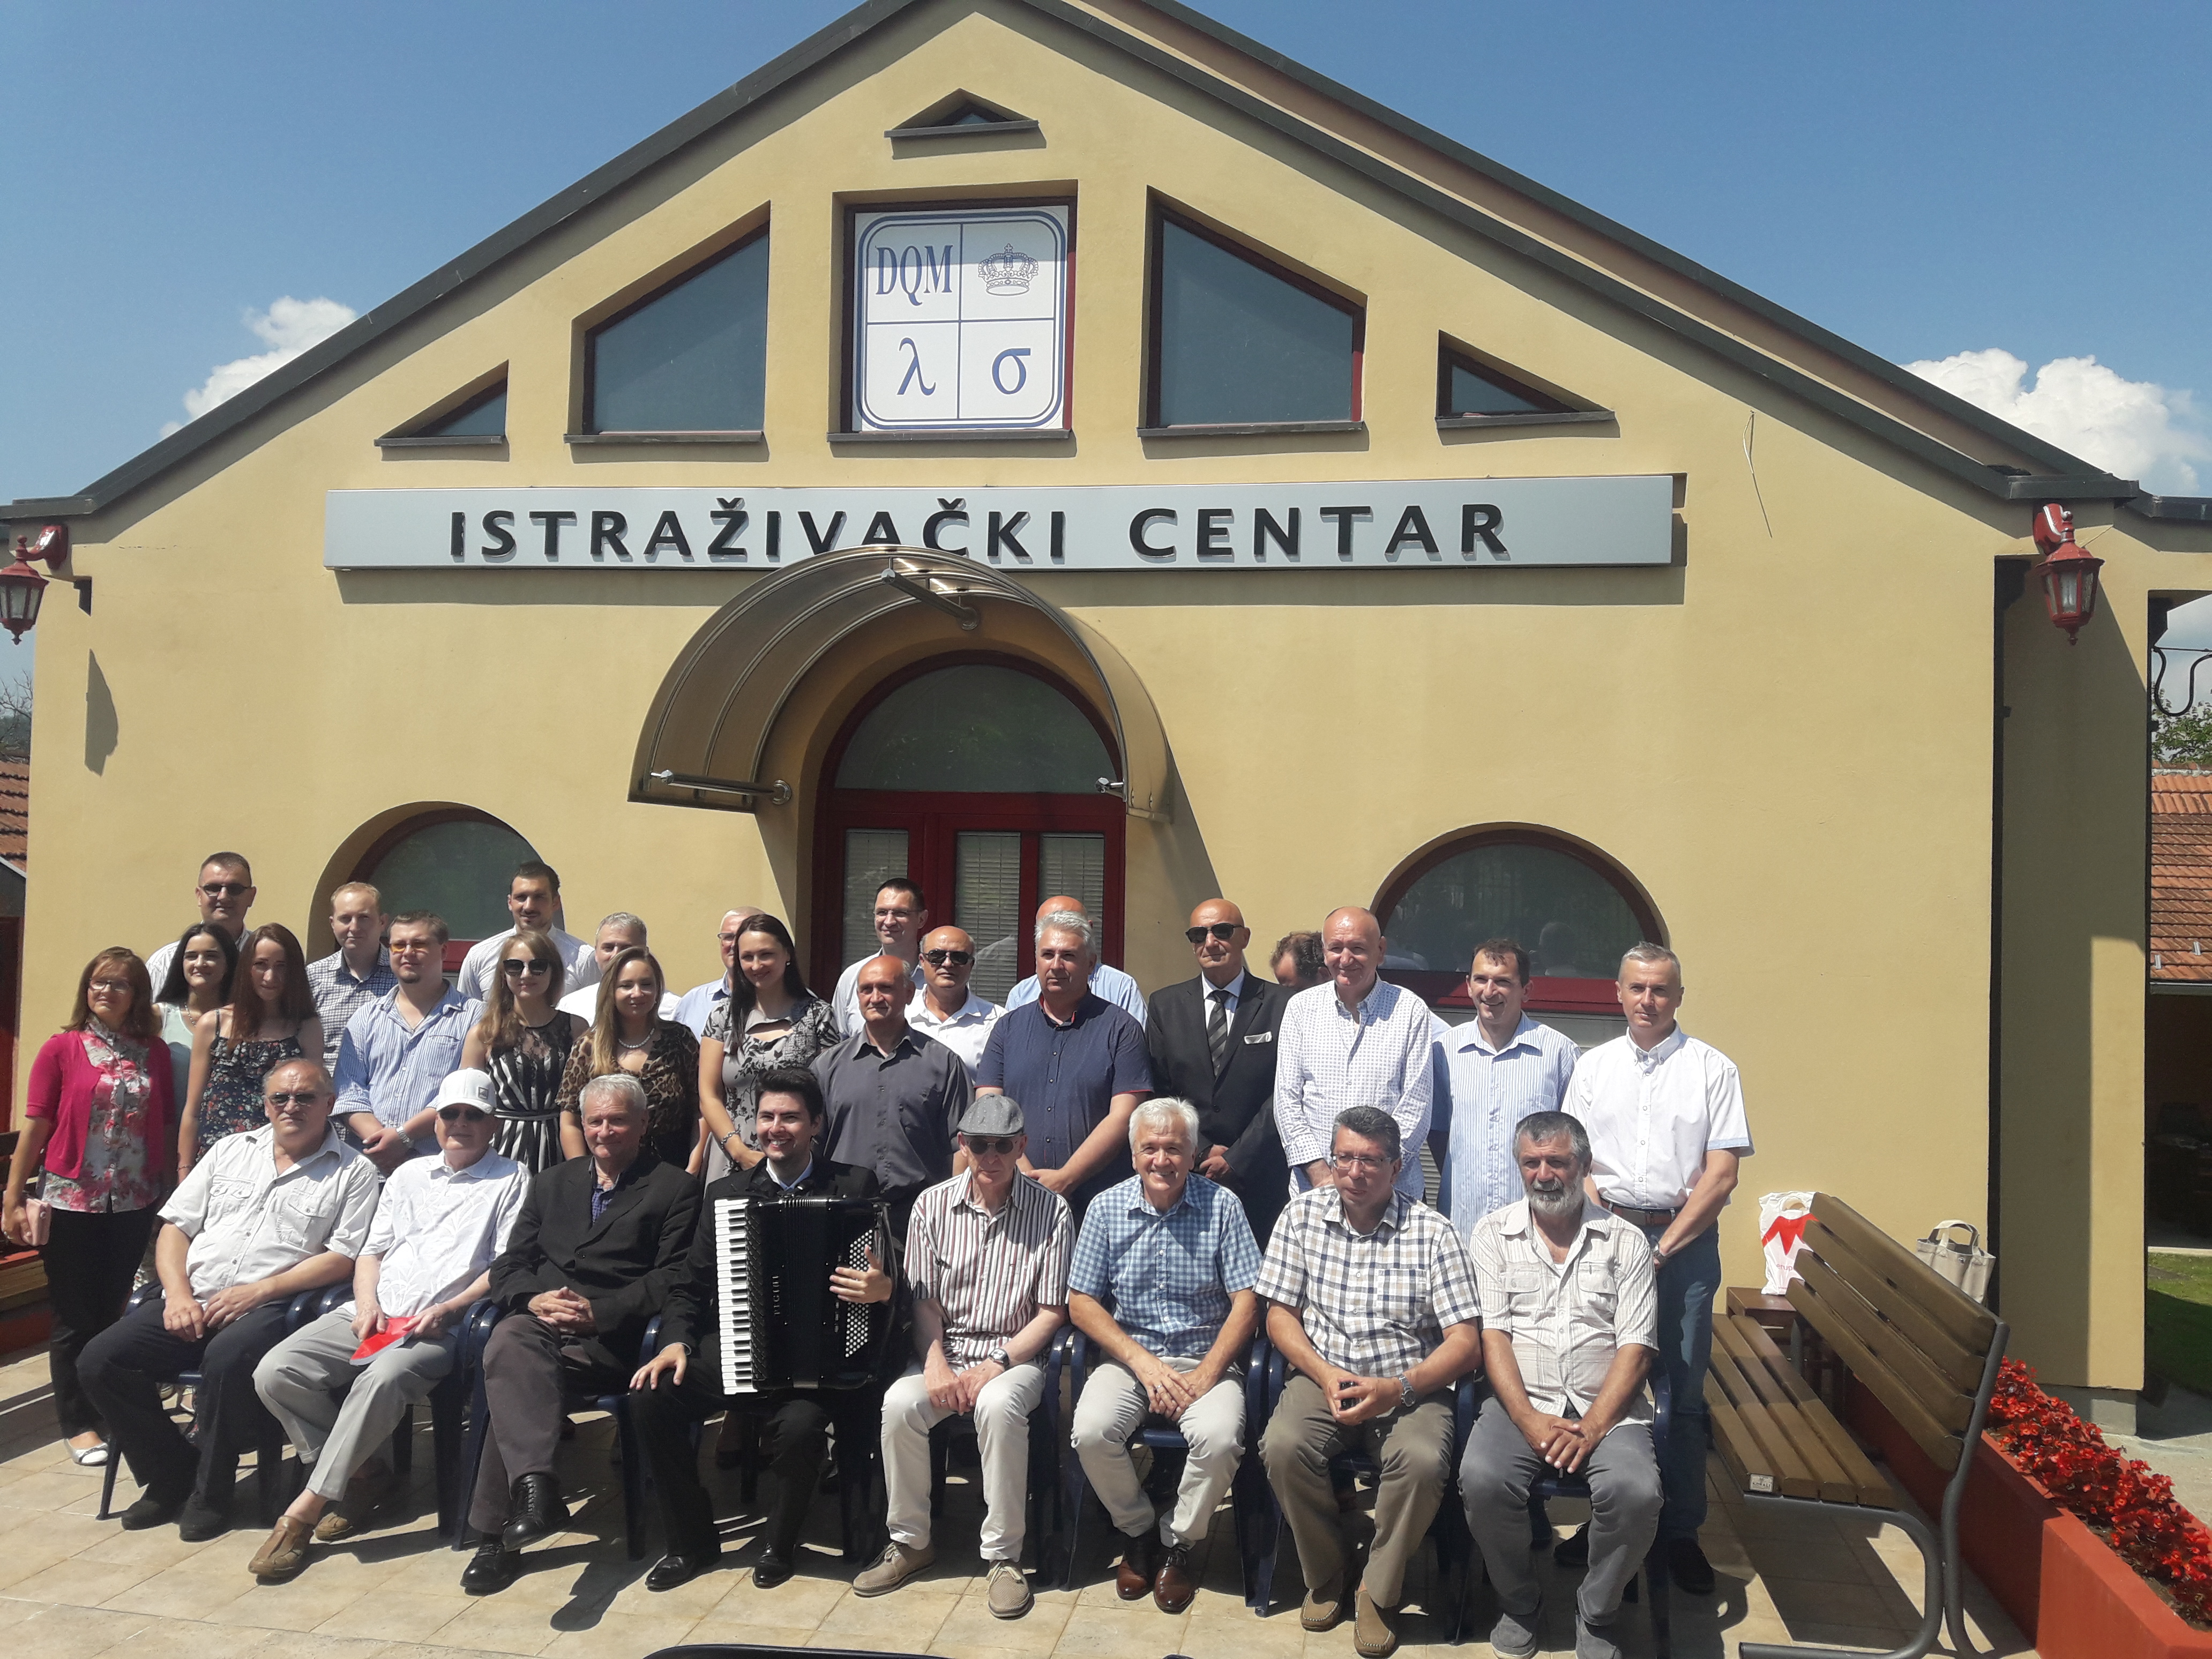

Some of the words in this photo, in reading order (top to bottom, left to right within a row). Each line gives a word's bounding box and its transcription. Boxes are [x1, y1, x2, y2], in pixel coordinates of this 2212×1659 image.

[875, 245, 953, 306] DQM
[896, 337, 936, 396] λ
[991, 348, 1031, 395] σ
[451, 497, 1064, 558] ISTRAŽIVAČKI
[1129, 504, 1509, 558] CENTAR
